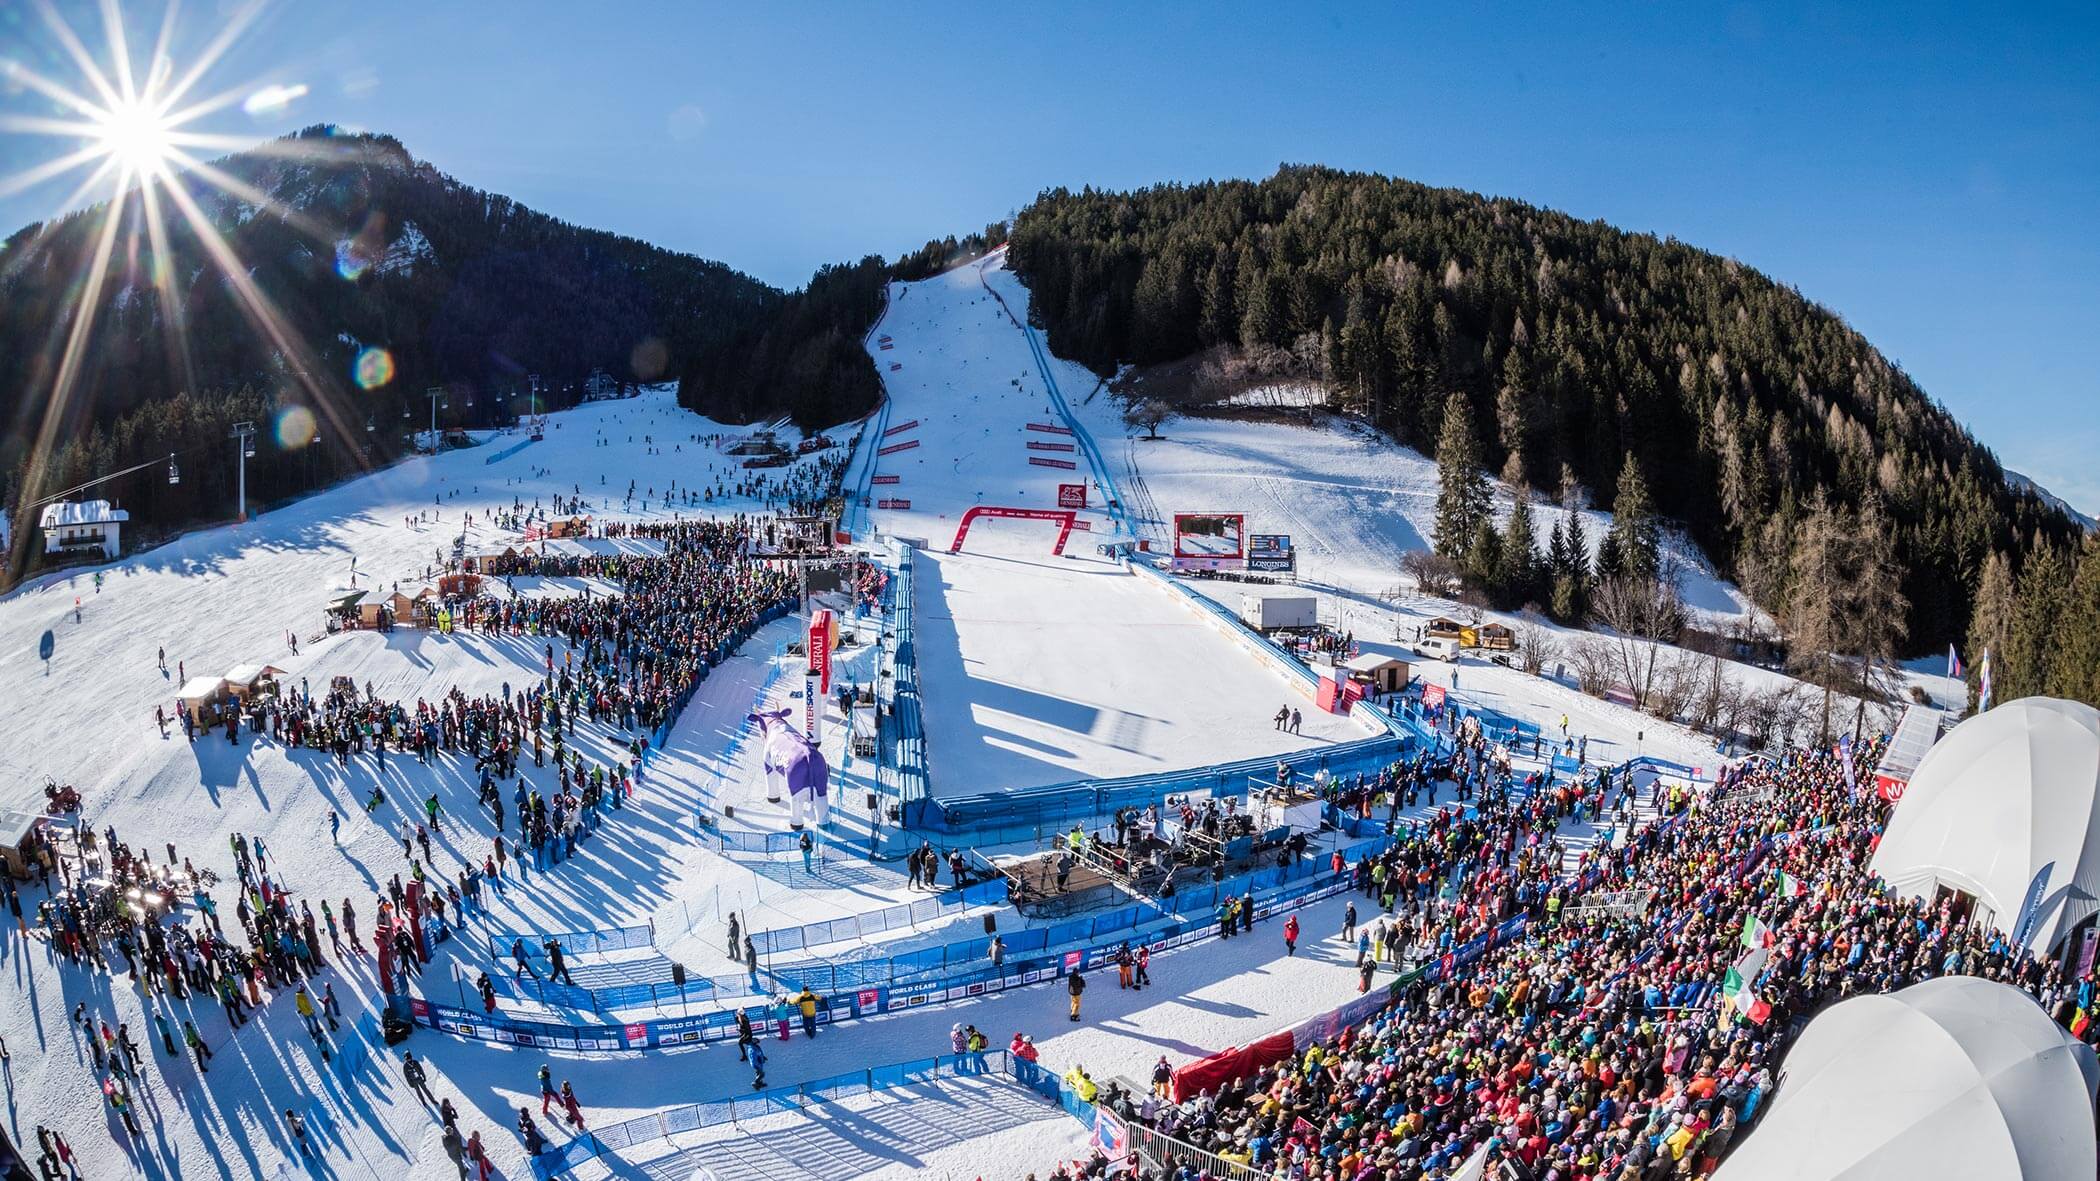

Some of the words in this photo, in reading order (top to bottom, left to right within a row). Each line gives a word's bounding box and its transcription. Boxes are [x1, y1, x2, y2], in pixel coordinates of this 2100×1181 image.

[1251, 560, 1289, 568] LONGINES
[813, 635, 823, 673] NERALI
[806, 680, 814, 731] INTERSPORT
[888, 986, 913, 996] WORLD
[914, 982, 937, 992] CLASS
[437, 1009, 460, 1018] WORLD
[656, 1022, 684, 1031] WORLD
[685, 1018, 710, 1027] CLASS
